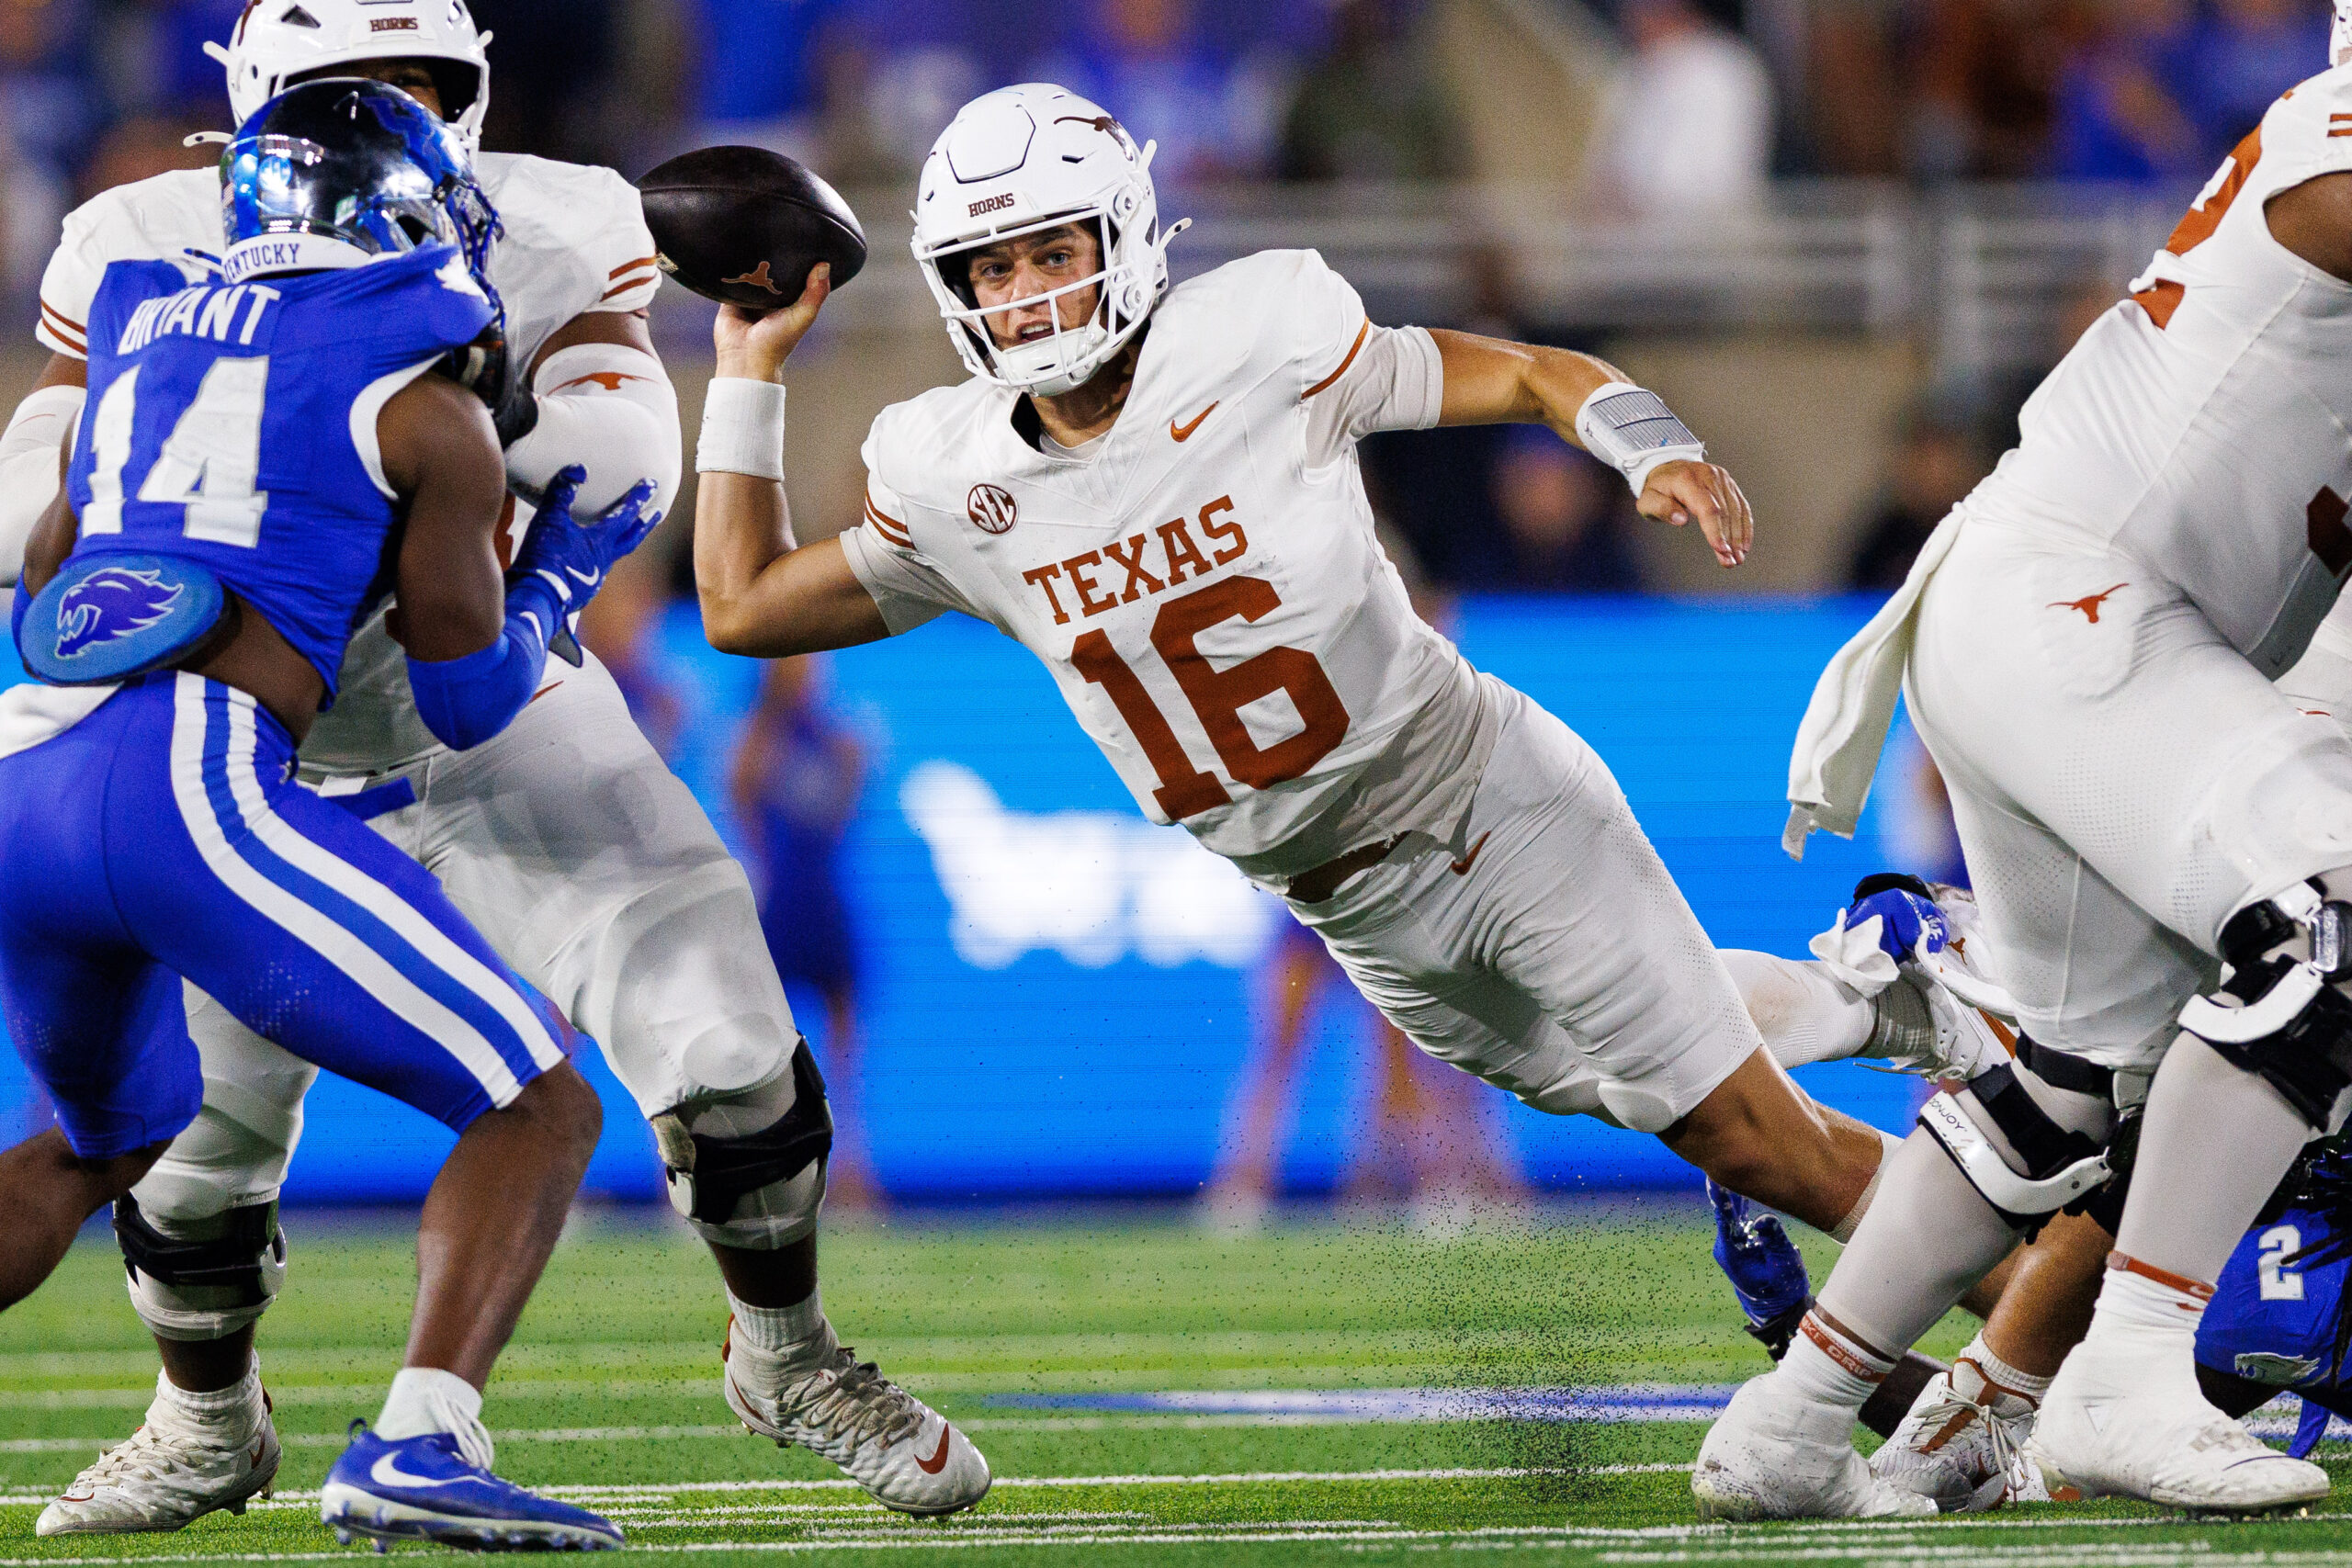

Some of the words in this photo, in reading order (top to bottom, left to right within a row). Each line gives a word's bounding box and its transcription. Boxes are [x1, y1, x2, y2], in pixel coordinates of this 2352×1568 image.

[370, 17, 418, 31] HORNS
[967, 192, 1015, 218] HORNS
[224, 243, 300, 281] ENTUCKY
[117, 284, 281, 355] BRYANT
[82, 355, 269, 548] 14
[967, 483, 1017, 535] SEC
[1023, 494, 1249, 625] TEXAS
[1071, 574, 1350, 820] 16
[2258, 1224, 2304, 1301] 2
